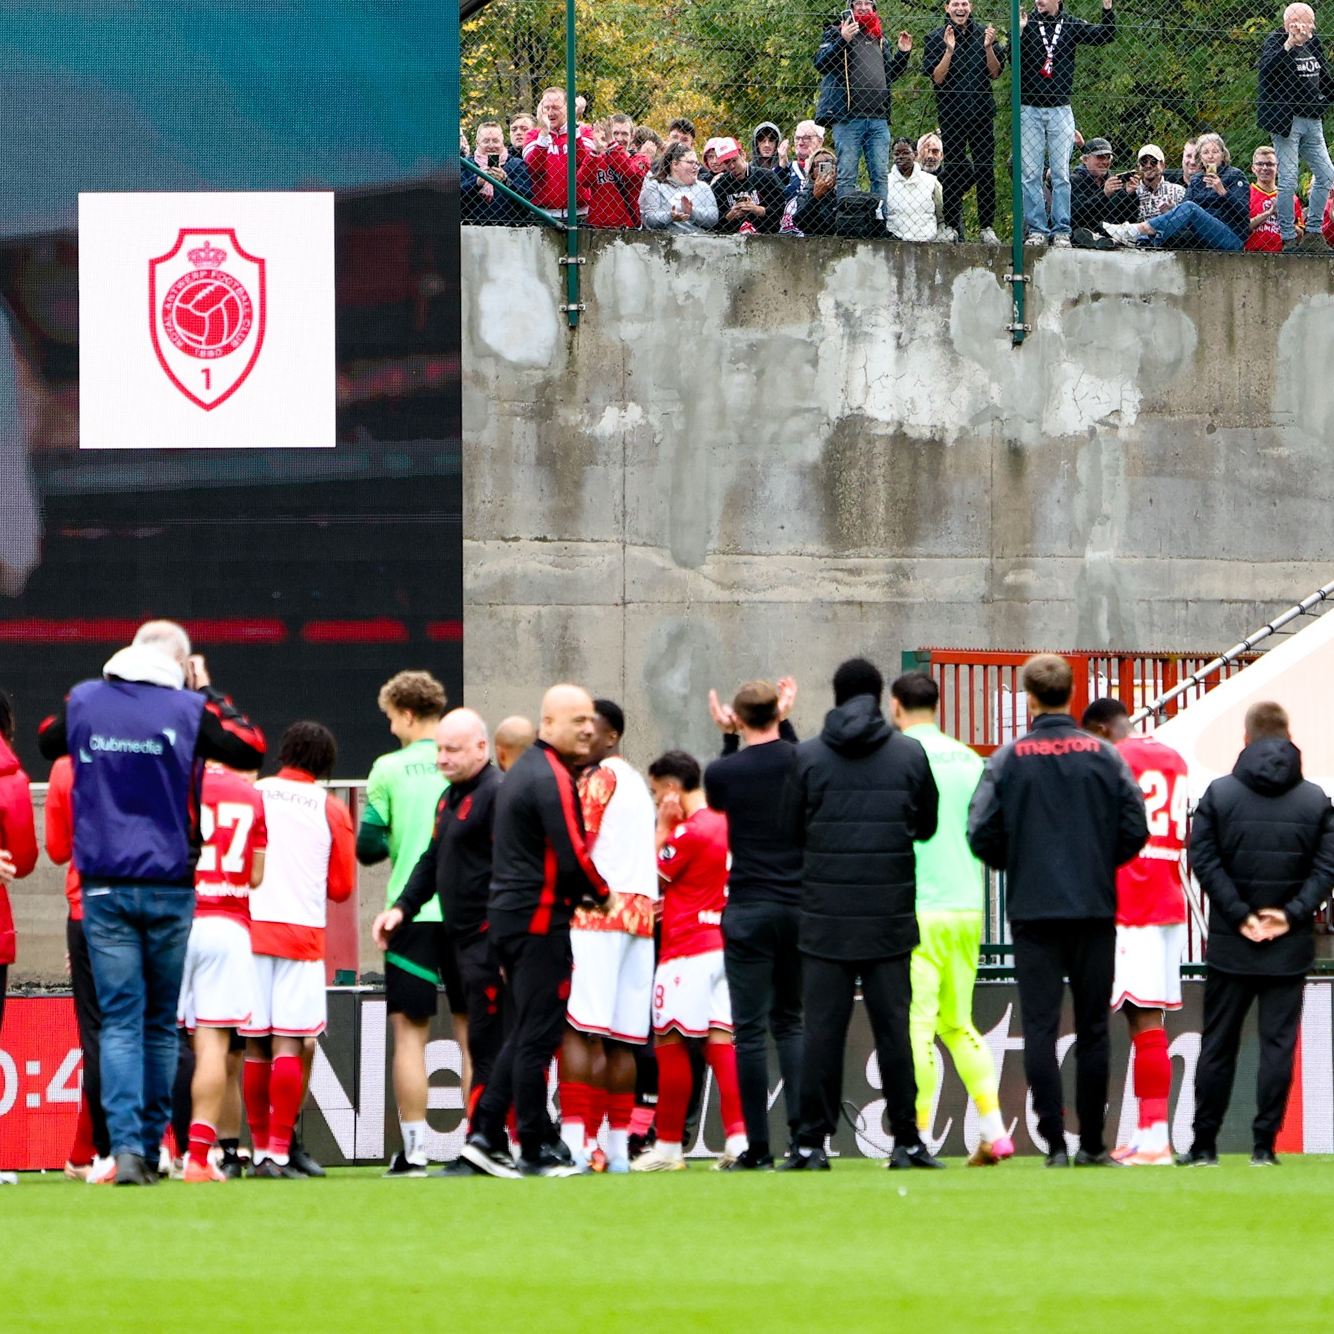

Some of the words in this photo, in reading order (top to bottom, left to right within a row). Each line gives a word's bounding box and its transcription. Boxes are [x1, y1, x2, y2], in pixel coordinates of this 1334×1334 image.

[200, 367, 210, 390] 1
[88, 733, 165, 756] Clubmedia
[1014, 736, 1101, 758] macron
[929, 750, 978, 765] acron
[404, 761, 439, 778] ma
[1138, 769, 1189, 841] 24
[195, 802, 254, 873] 27
[655, 984, 665, 1009] 8
